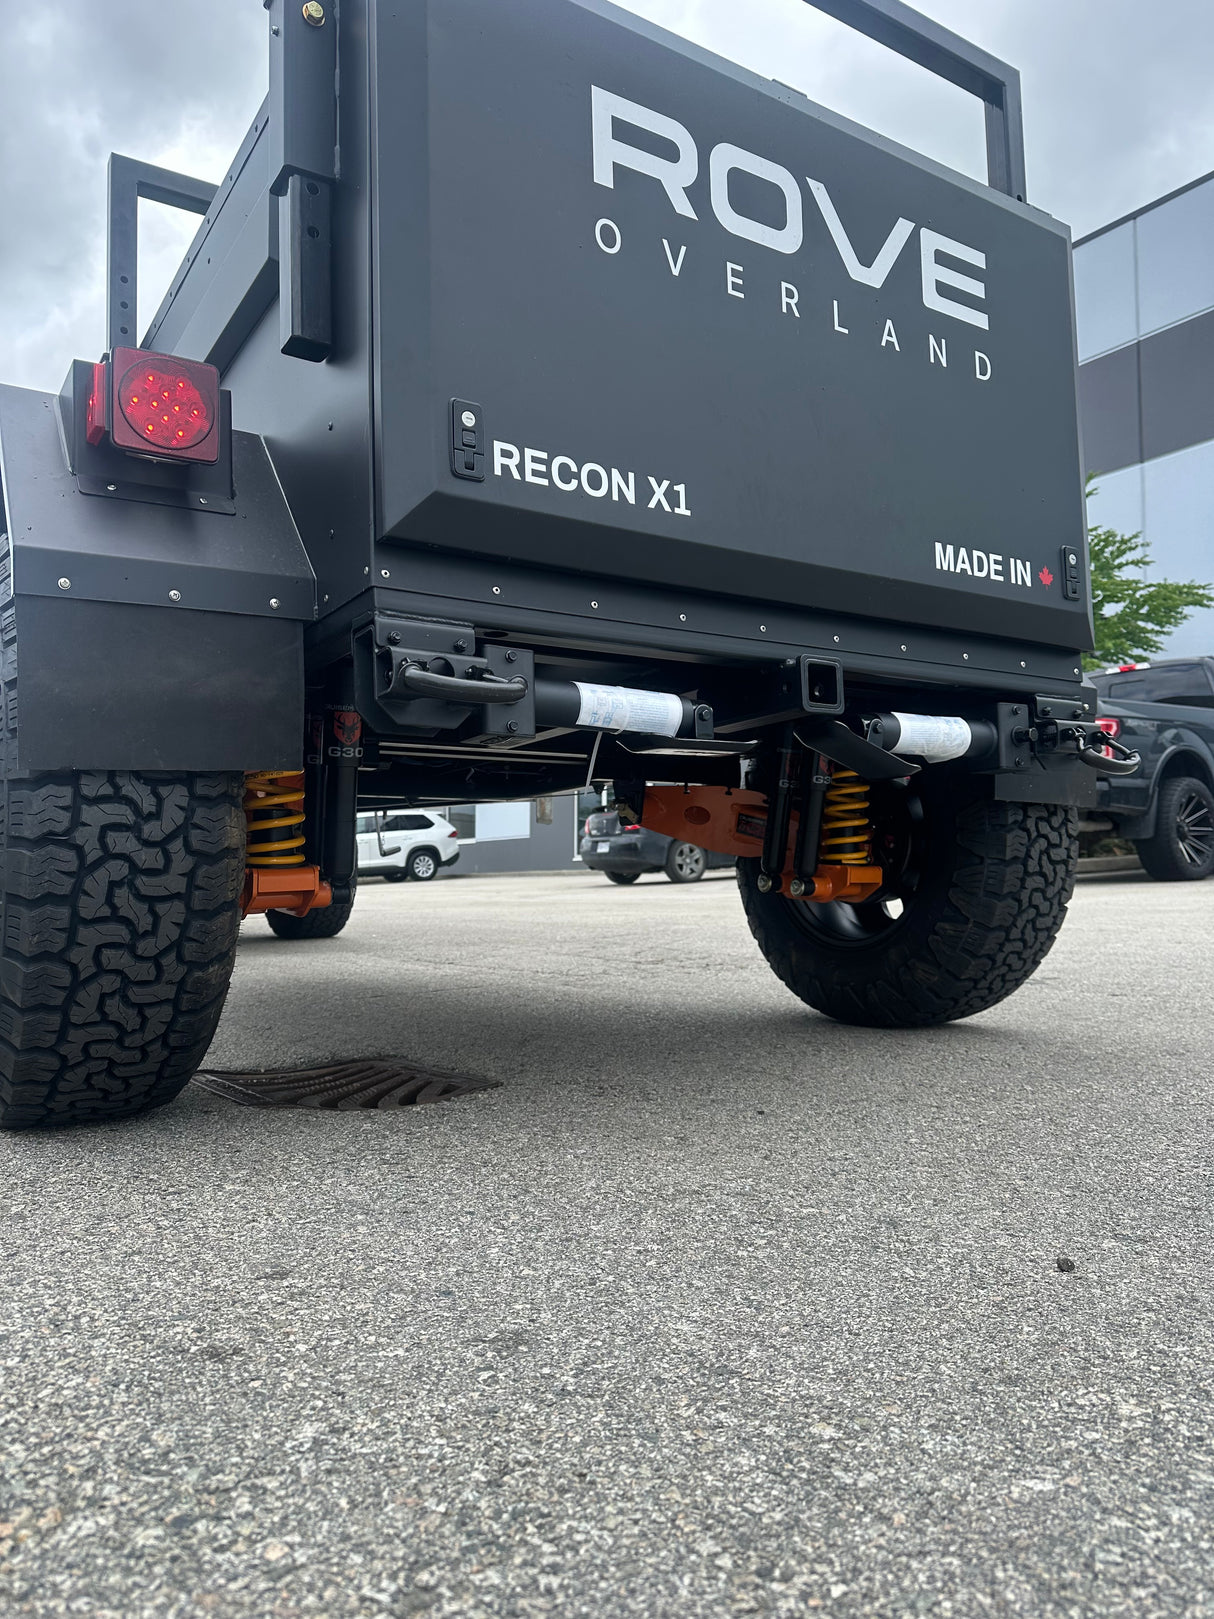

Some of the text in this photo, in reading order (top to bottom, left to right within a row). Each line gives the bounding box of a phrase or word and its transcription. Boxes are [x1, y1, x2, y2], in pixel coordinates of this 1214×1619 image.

[592, 84, 990, 331] ROVE
[594, 218, 992, 381] OVERLAND
[493, 440, 692, 517] RECON X1
[935, 541, 1032, 588] MADE IN
[328, 746, 364, 758] G30
[778, 778, 800, 788] G3
[812, 775, 833, 785] G3
